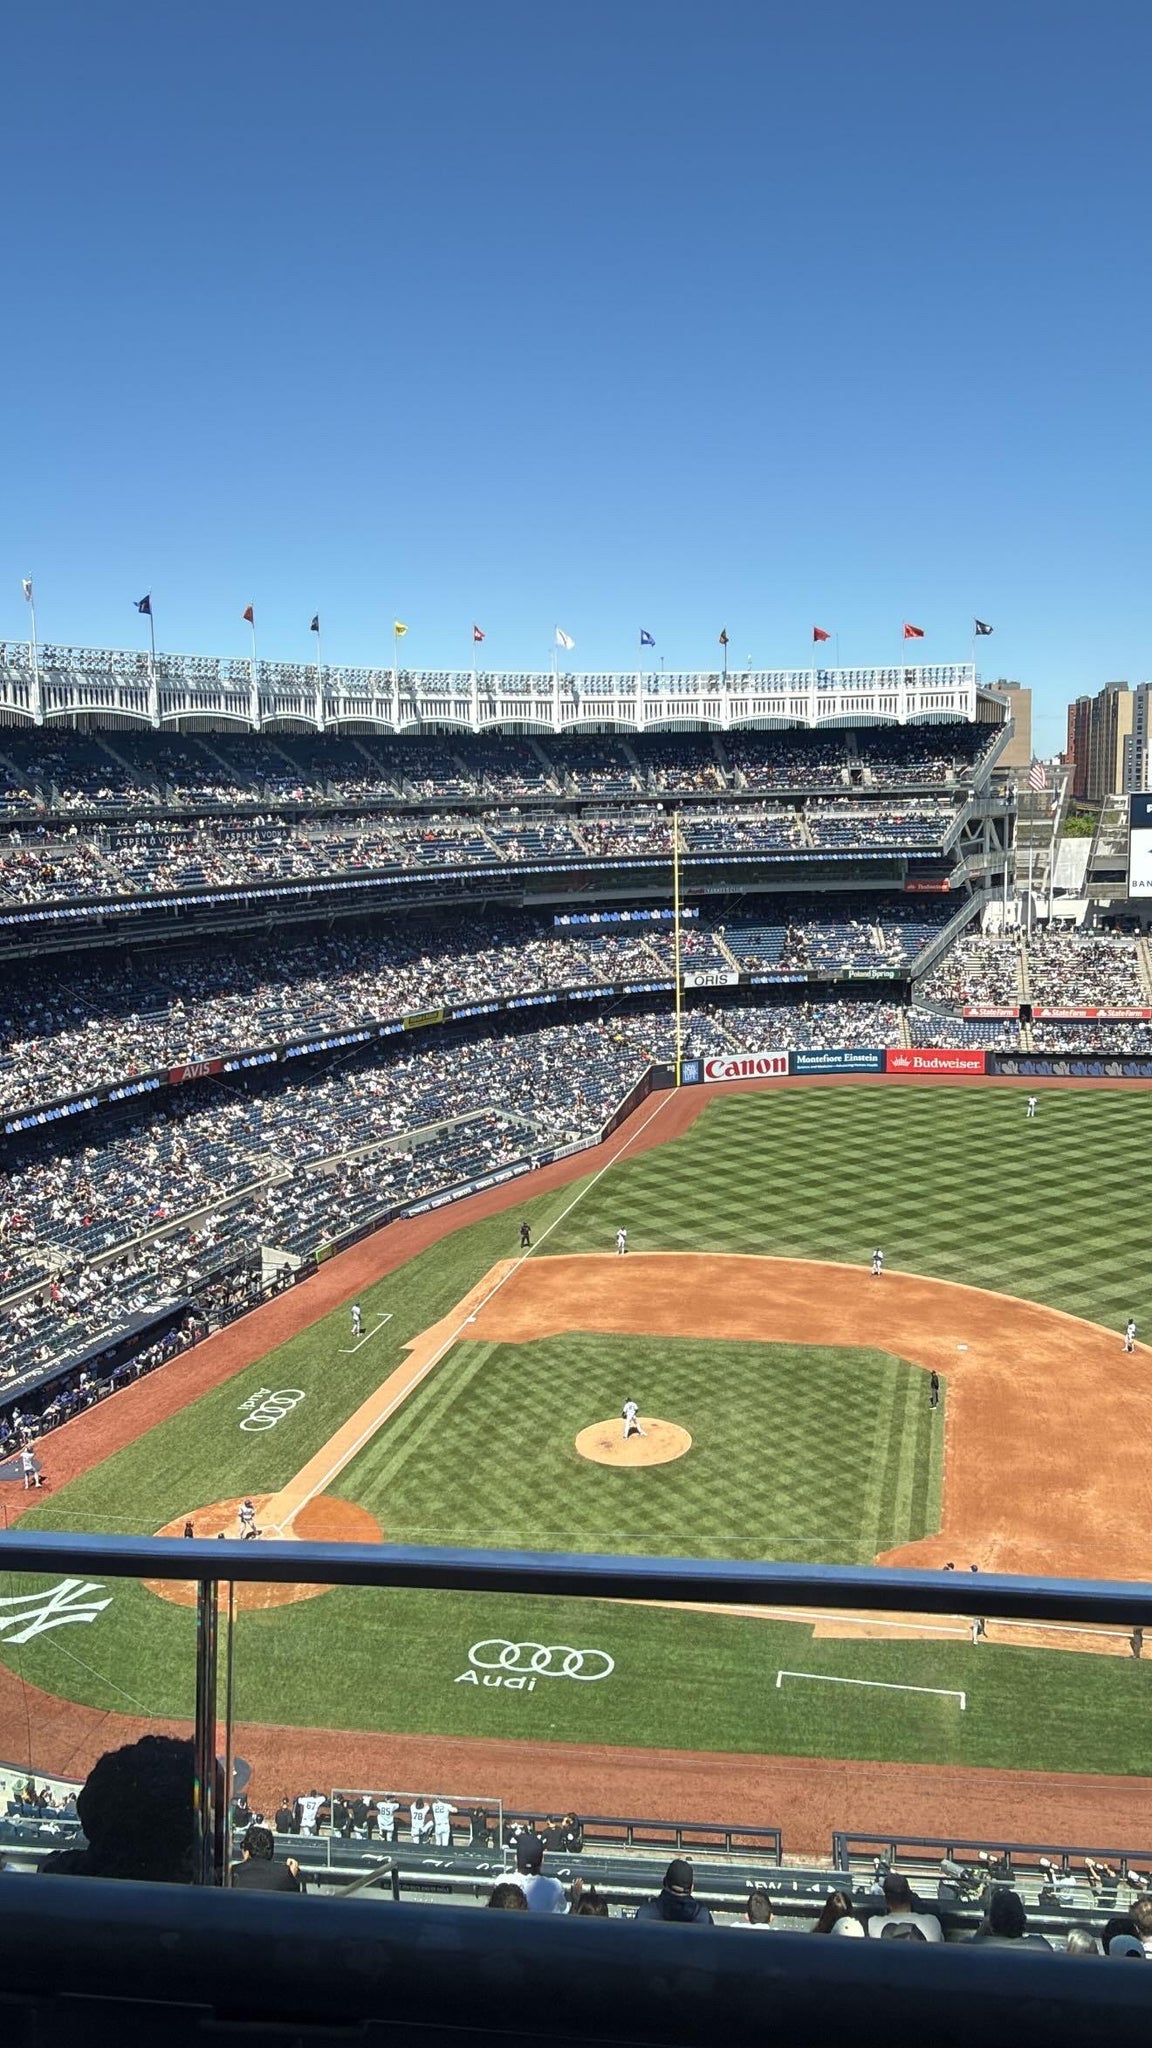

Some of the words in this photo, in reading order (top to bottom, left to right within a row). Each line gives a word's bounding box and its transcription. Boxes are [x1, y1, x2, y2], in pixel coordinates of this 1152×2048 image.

[116, 838, 147, 847] ASPEN
[158, 834, 188, 845] VODKA
[225, 831, 250, 841] ASPEN
[261, 830, 287, 839] VODKA
[848, 970, 871, 979] Poland
[871, 969, 894, 980] Spring
[694, 975, 728, 987] ORIS
[796, 1054, 842, 1064] Montefiore
[844, 1053, 878, 1062] Einstein
[913, 1056, 981, 1069] Budweiser
[182, 1062, 210, 1080] AVIS
[705, 1056, 787, 1079] Canon
[237, 1387, 272, 1410] Audi
[454, 1670, 537, 1691] Audi
[306, 1802, 317, 1810] 67
[381, 1807, 391, 1816] 85
[435, 1805, 445, 1813] 22
[413, 1812, 423, 1820] 78
